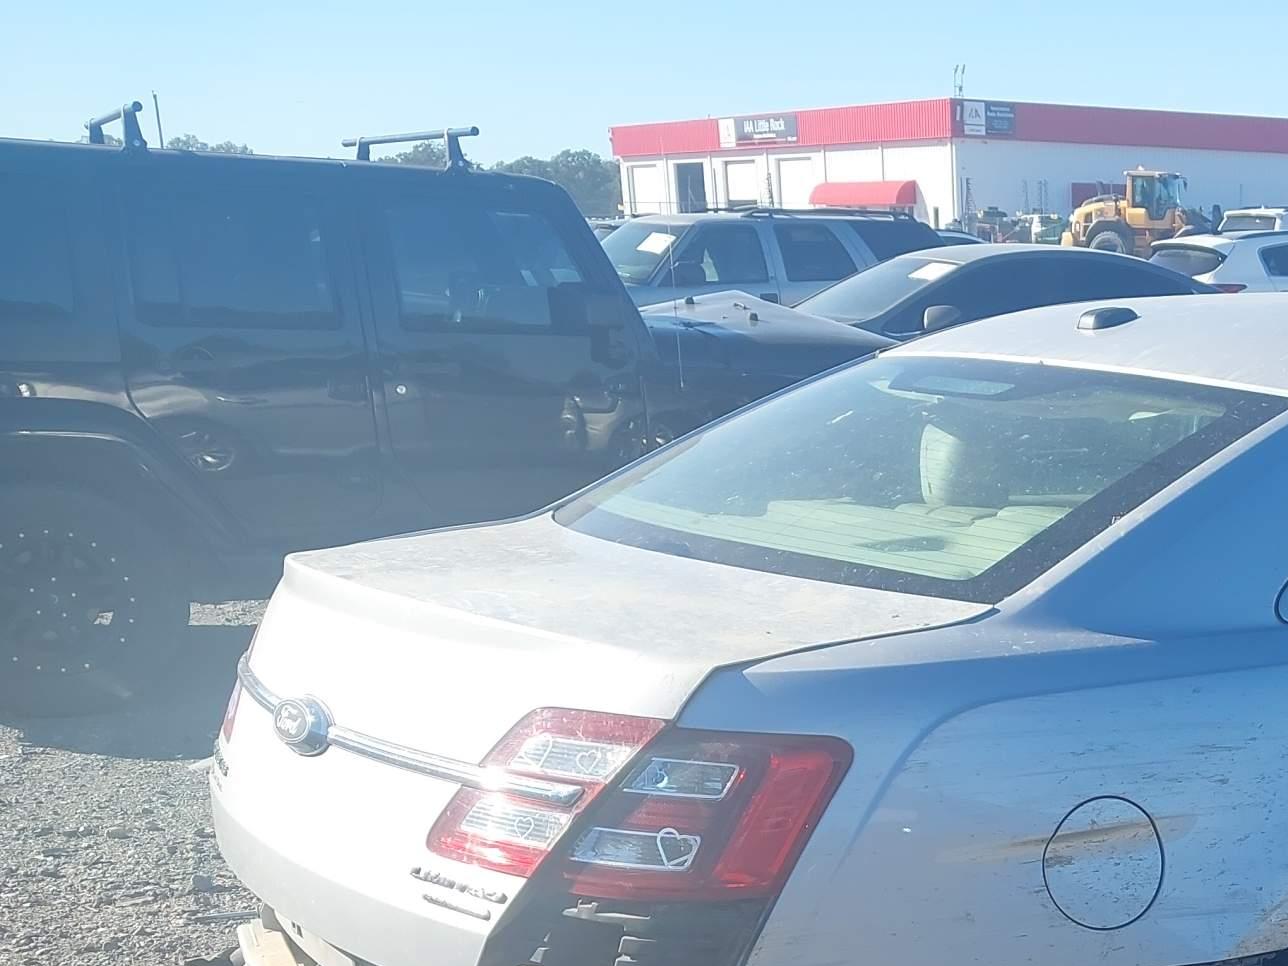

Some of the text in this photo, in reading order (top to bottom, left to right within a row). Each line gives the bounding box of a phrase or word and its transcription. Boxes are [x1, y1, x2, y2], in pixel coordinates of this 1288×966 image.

[743, 117, 785, 133] IAA Little Rock
